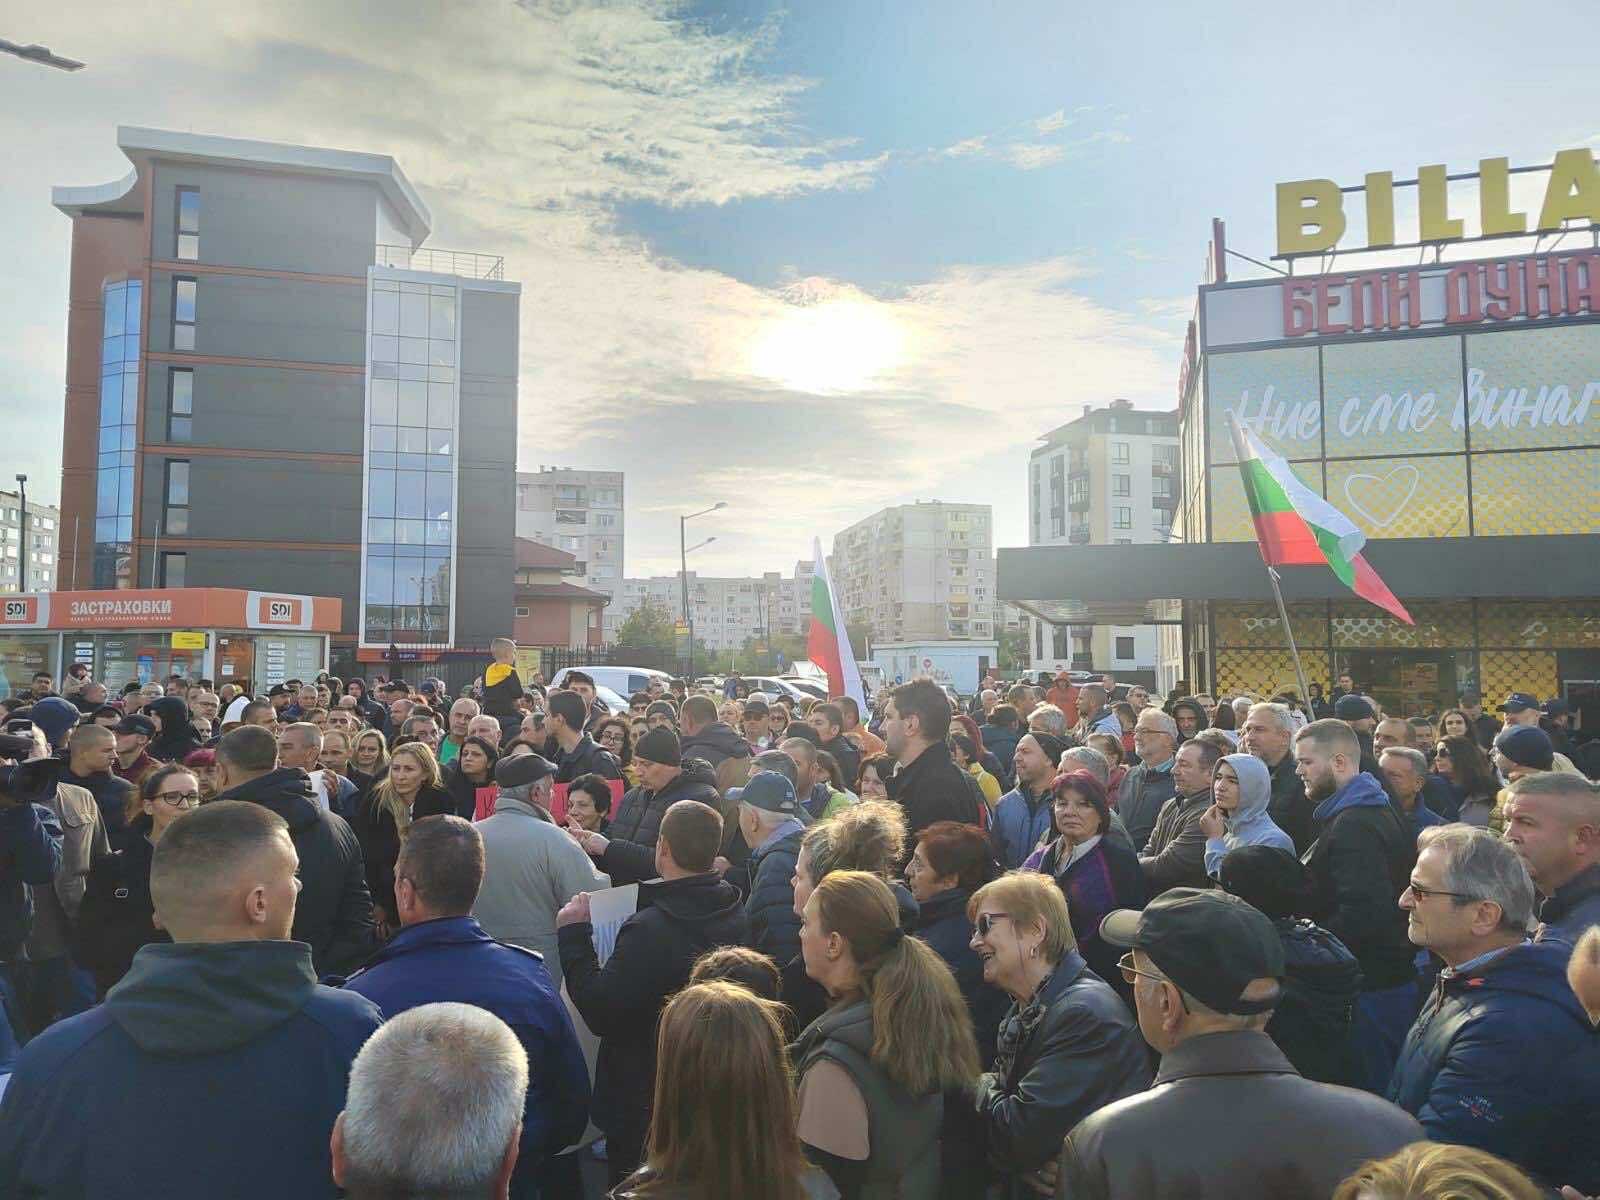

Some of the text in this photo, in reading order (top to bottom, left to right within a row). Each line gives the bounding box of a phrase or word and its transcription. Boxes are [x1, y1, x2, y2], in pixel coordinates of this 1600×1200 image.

[1276, 147, 1600, 256] BILLA
[1338, 388, 1440, 438] сме
[7, 603, 26, 615] SDI
[71, 600, 172, 615] ЗАСТРАХОВКИ
[271, 603, 291, 616] SDI
